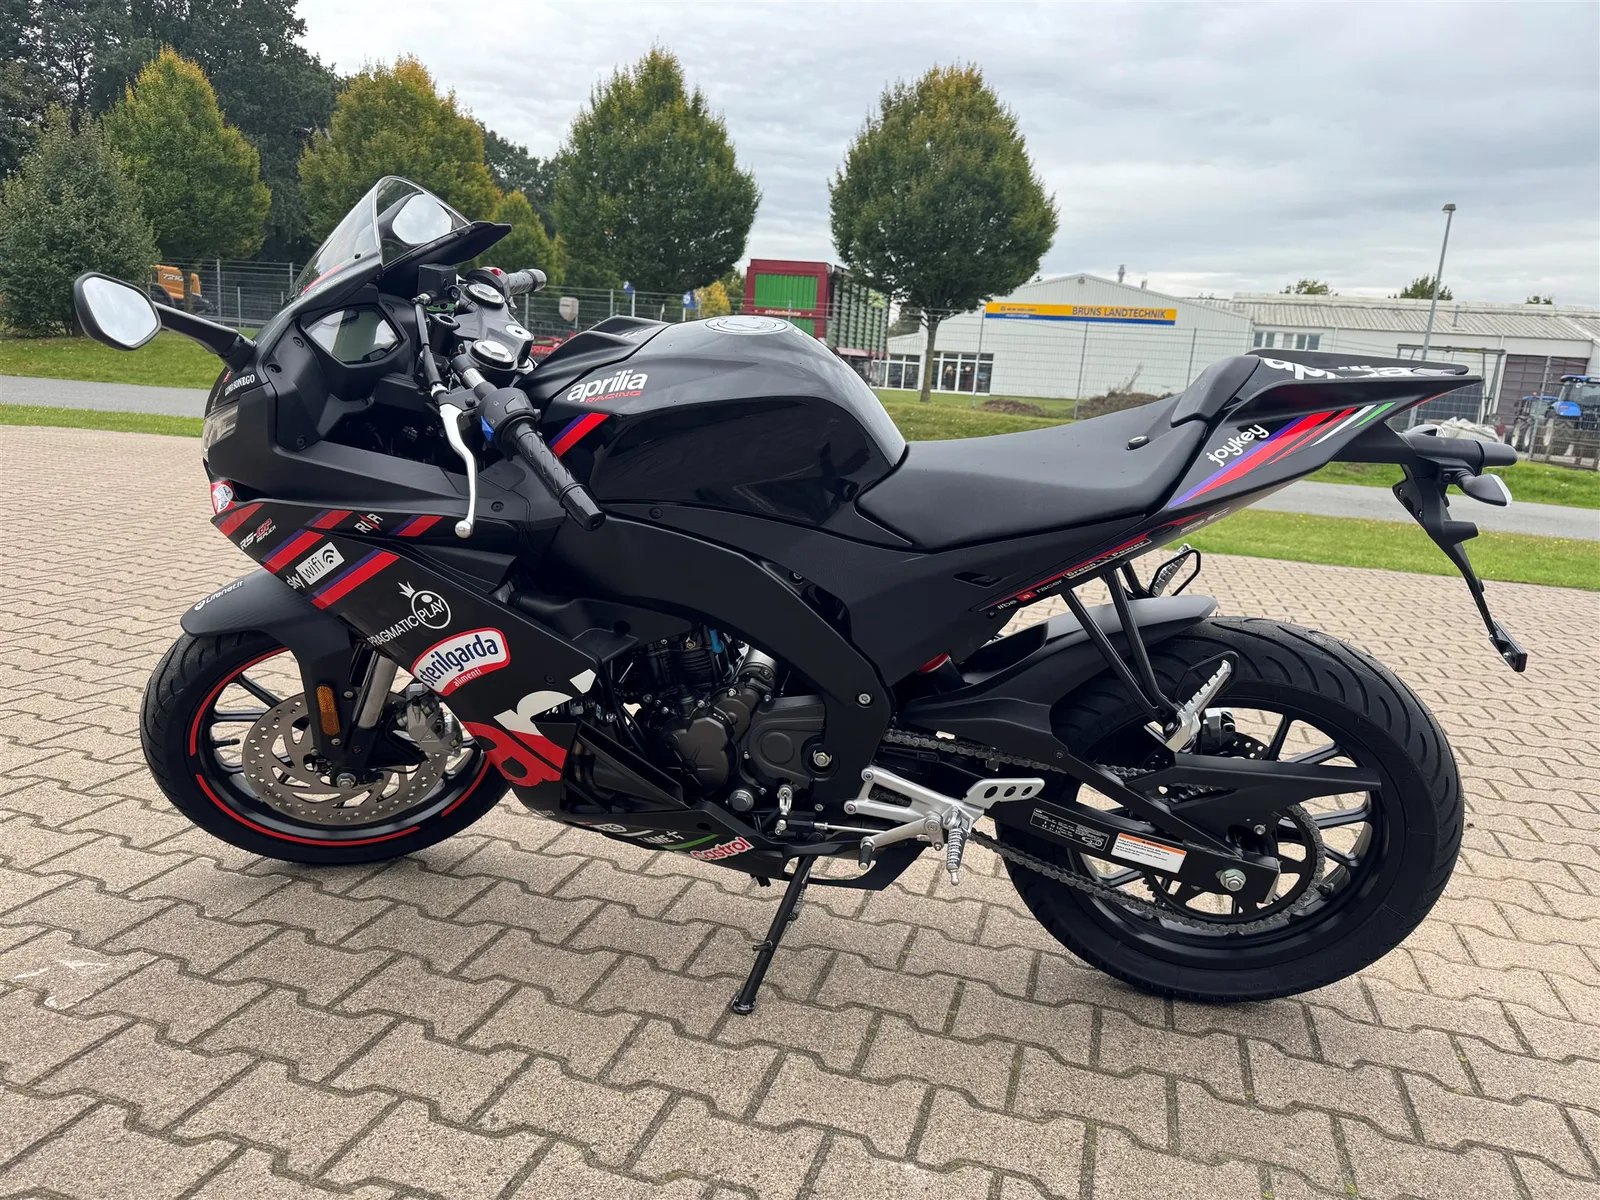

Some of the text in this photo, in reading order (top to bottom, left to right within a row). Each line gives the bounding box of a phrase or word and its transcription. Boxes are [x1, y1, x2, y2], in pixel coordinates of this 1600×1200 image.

[1072, 306, 1166, 319] BRUNS LANDTECHNIK
[567, 369, 648, 402] aprilia
[586, 390, 642, 404] RACING
[1206, 424, 1270, 467] joykey
[283, 556, 326, 590] sky wifi
[367, 600, 445, 646] PRAGMATIC PLAY
[420, 634, 498, 687] sterilgarda
[453, 668, 482, 687] alimenti
[691, 837, 753, 860] Castrol
